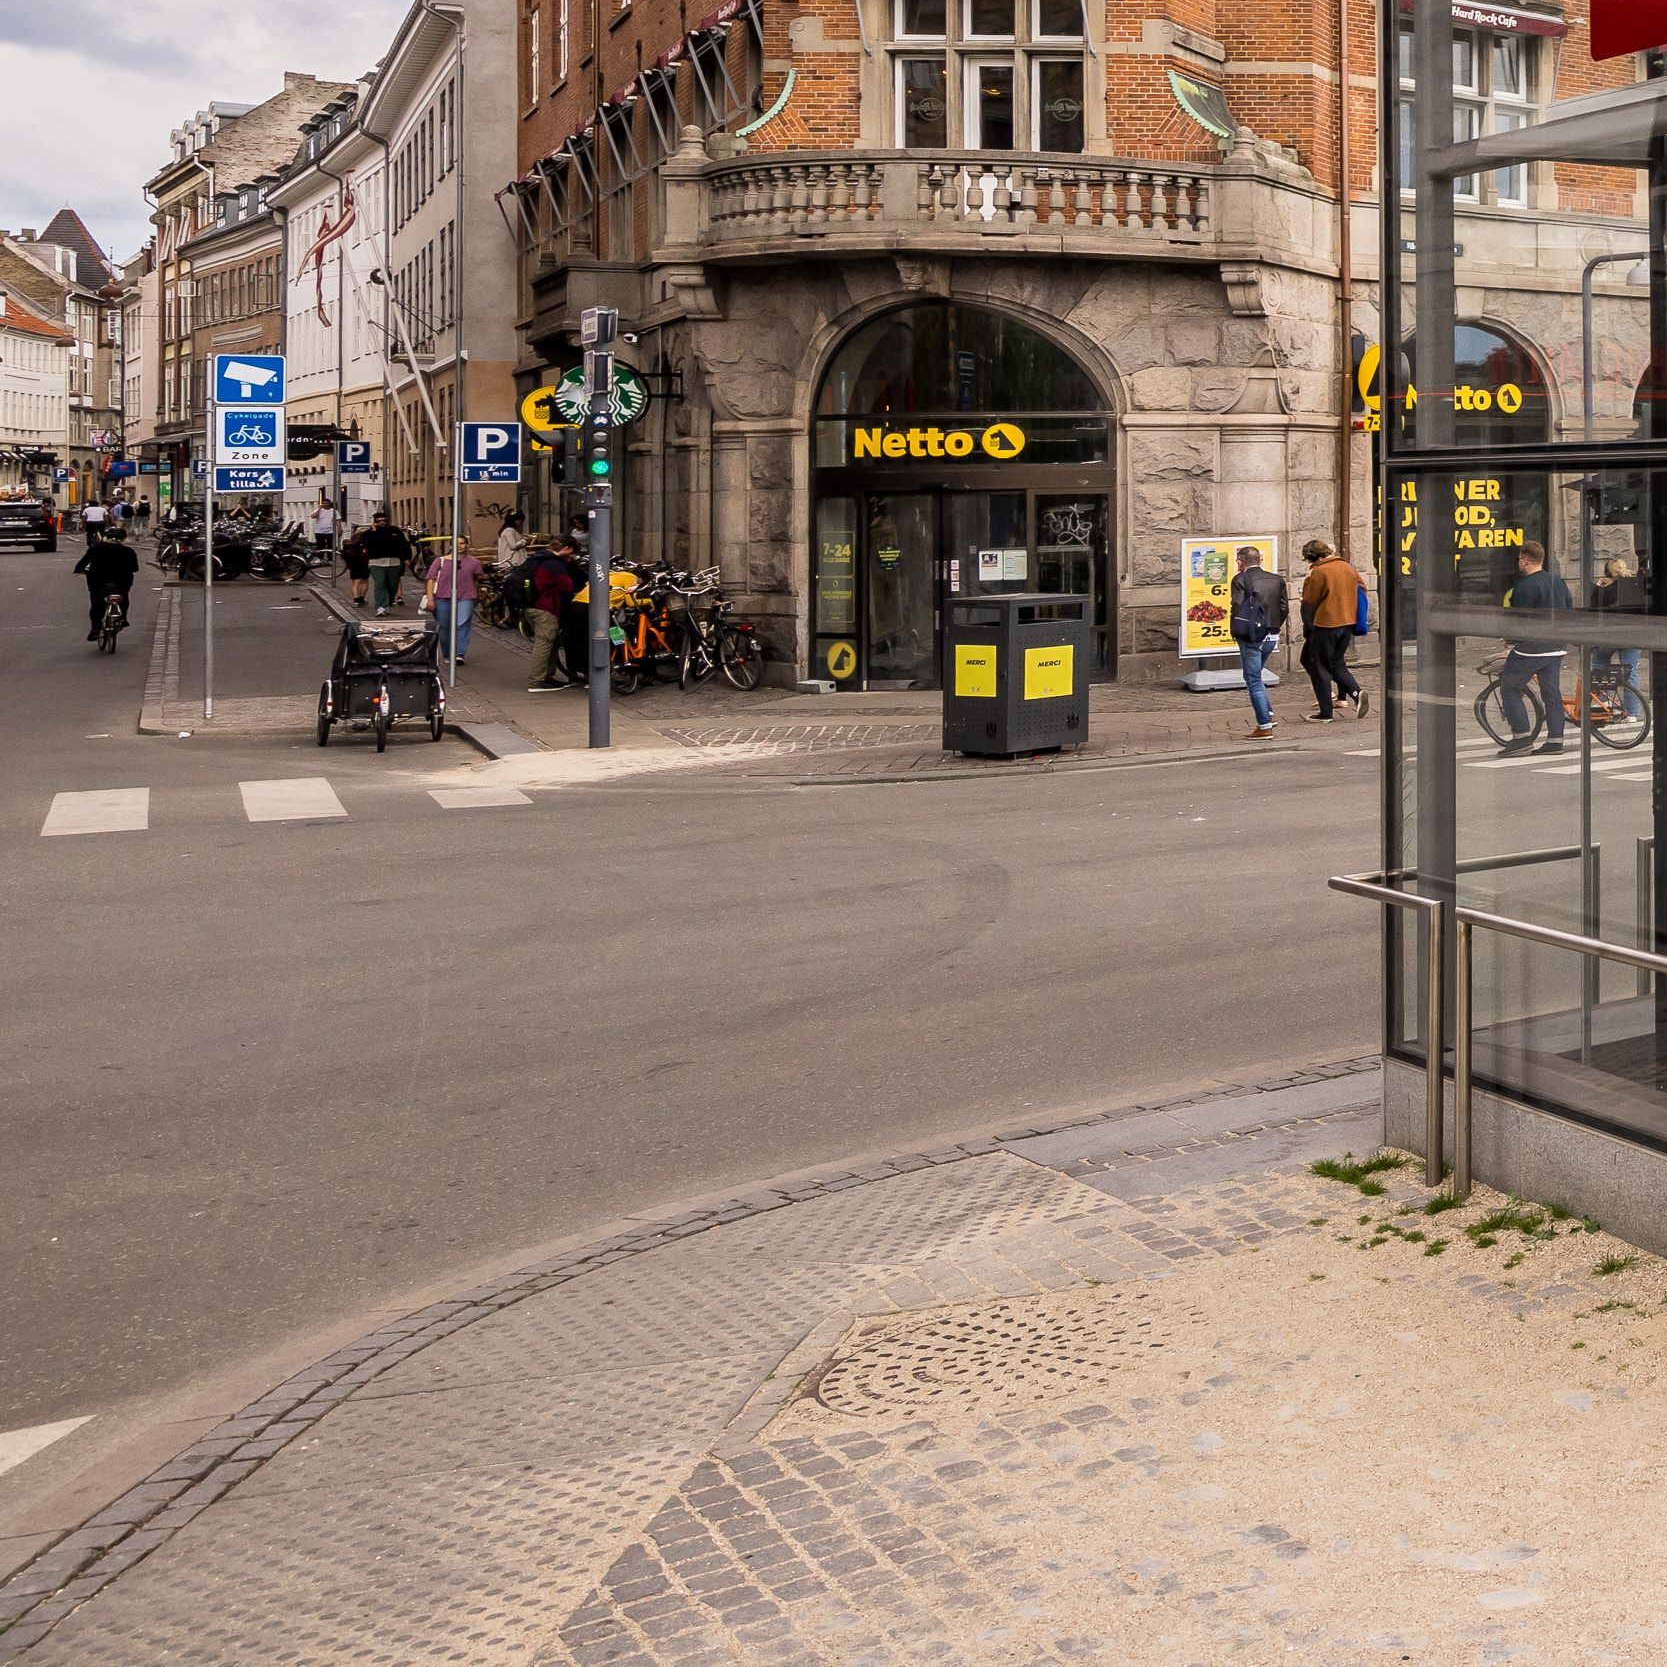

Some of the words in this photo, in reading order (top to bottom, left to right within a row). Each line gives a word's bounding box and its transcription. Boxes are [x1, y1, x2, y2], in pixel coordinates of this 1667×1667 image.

[1451, 5, 1475, 20] Hard
[1474, 10, 1498, 26] Rock
[1498, 14, 1518, 28] Cafe
[477, 427, 509, 461] P
[854, 427, 974, 458] Netto
[232, 451, 269, 460] Zone
[346, 444, 365, 462] P
[822, 542, 852, 557] 7-24
[1037, 659, 1062, 668] MERCI
